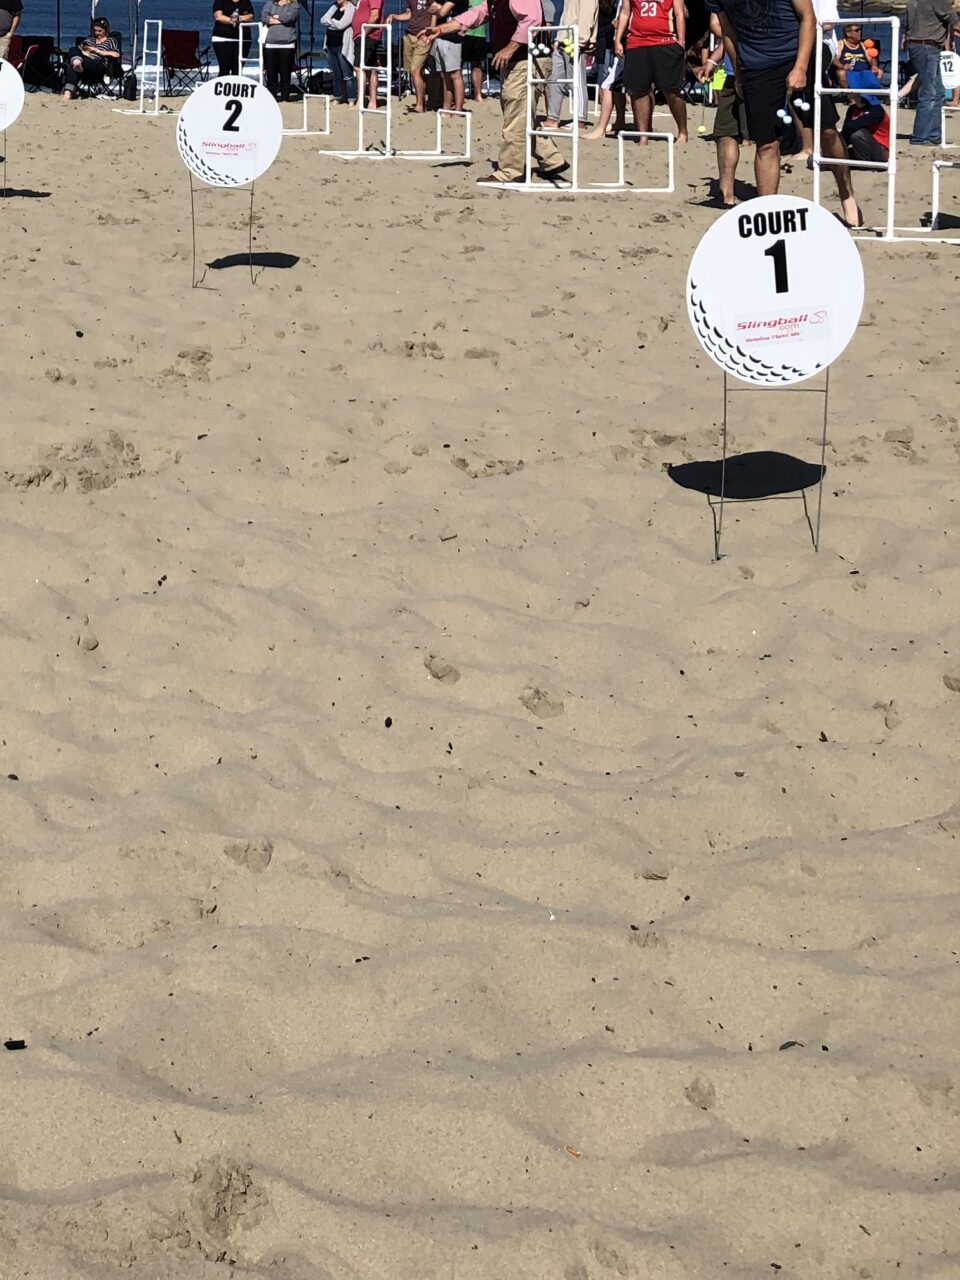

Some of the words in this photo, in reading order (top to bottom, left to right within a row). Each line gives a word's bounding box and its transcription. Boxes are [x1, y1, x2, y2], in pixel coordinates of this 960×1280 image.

[640, 2, 657, 17] 23
[942, 61, 954, 72] 12
[214, 82, 257, 98] COURT
[222, 99, 243, 132] 2
[738, 207, 809, 238] COURT
[764, 239, 789, 294] 1
[736, 314, 808, 331] Slingball
